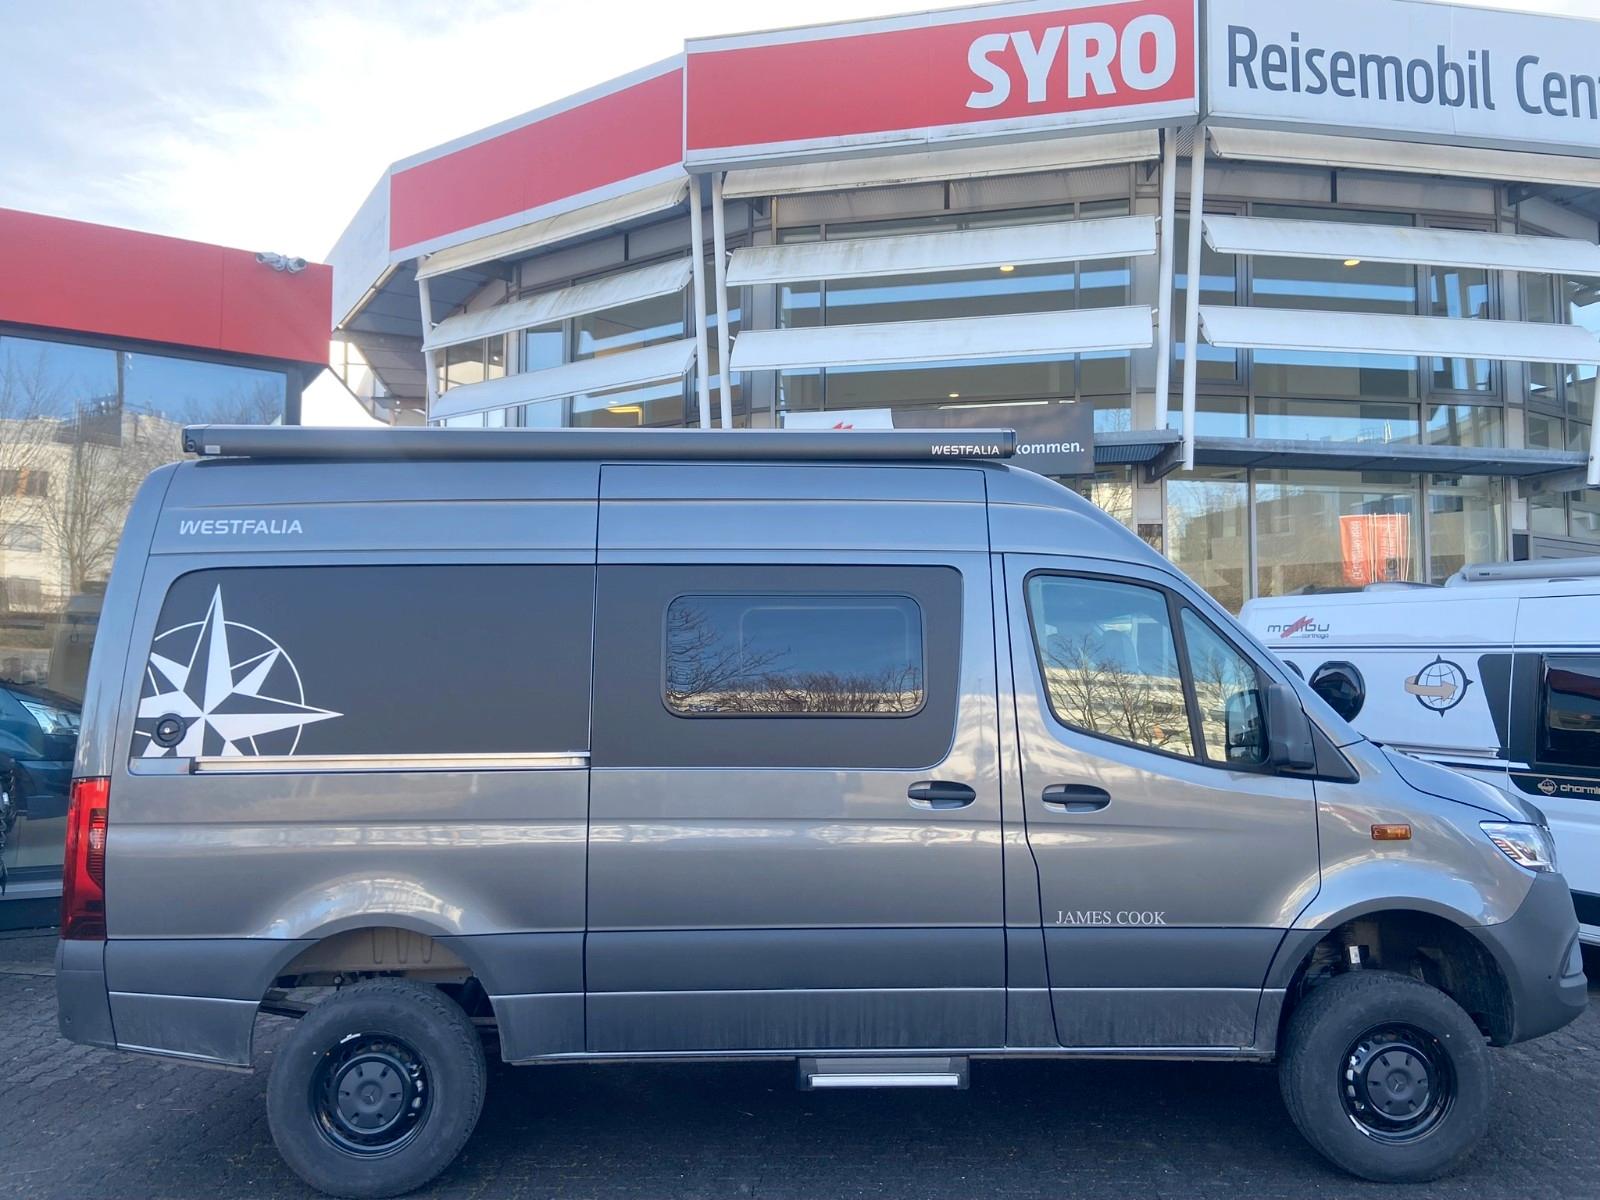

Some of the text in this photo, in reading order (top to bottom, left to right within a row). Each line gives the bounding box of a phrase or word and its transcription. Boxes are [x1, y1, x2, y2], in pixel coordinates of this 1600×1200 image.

[965, 14, 1177, 109] SYRO
[1227, 24, 1600, 120] Reisemobil Cen
[931, 445, 1000, 455] WESTFALIA
[179, 519, 304, 535] WESTFALIA
[1055, 910, 1166, 925] JAMES COOK
